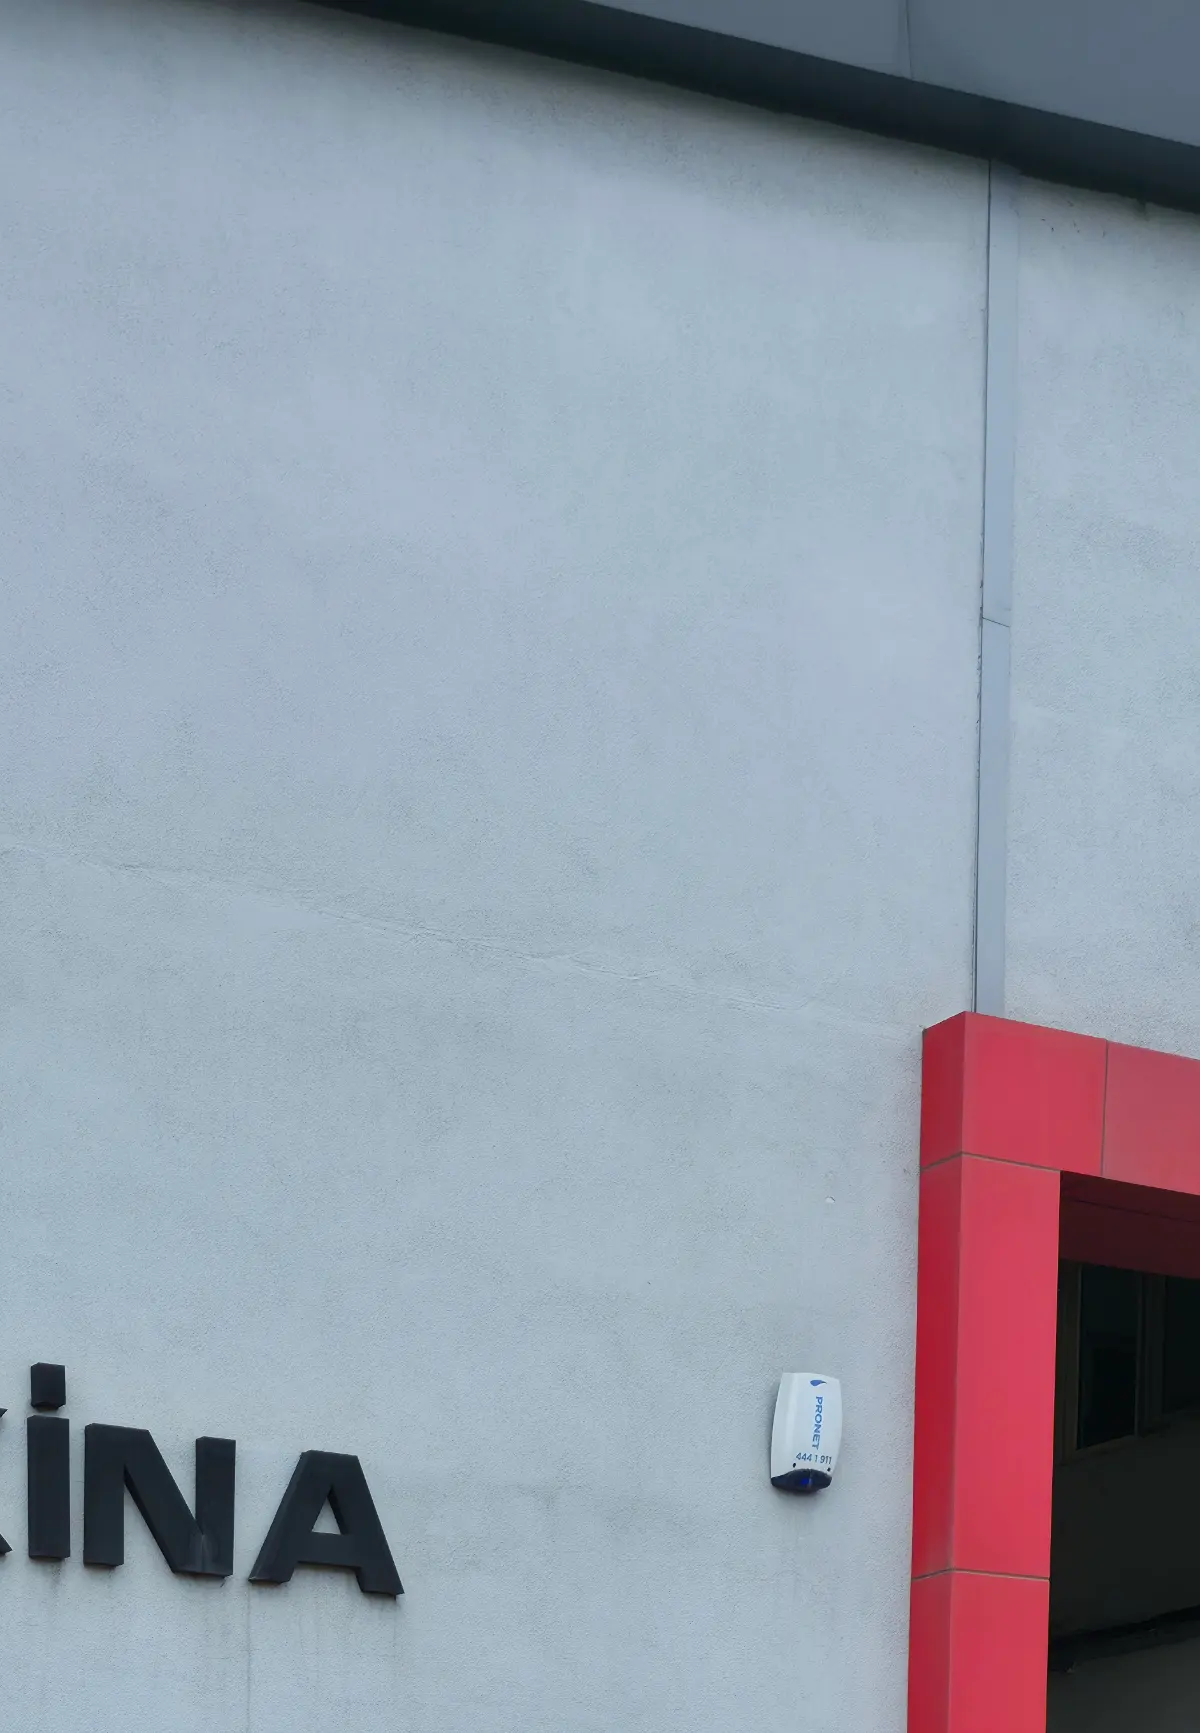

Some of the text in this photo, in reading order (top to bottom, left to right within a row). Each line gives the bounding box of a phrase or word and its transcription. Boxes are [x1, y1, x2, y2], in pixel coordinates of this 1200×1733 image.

[812, 1396, 823, 1450] PRONET
[795, 1452, 812, 1462] 444
[820, 1455, 832, 1464] 911
